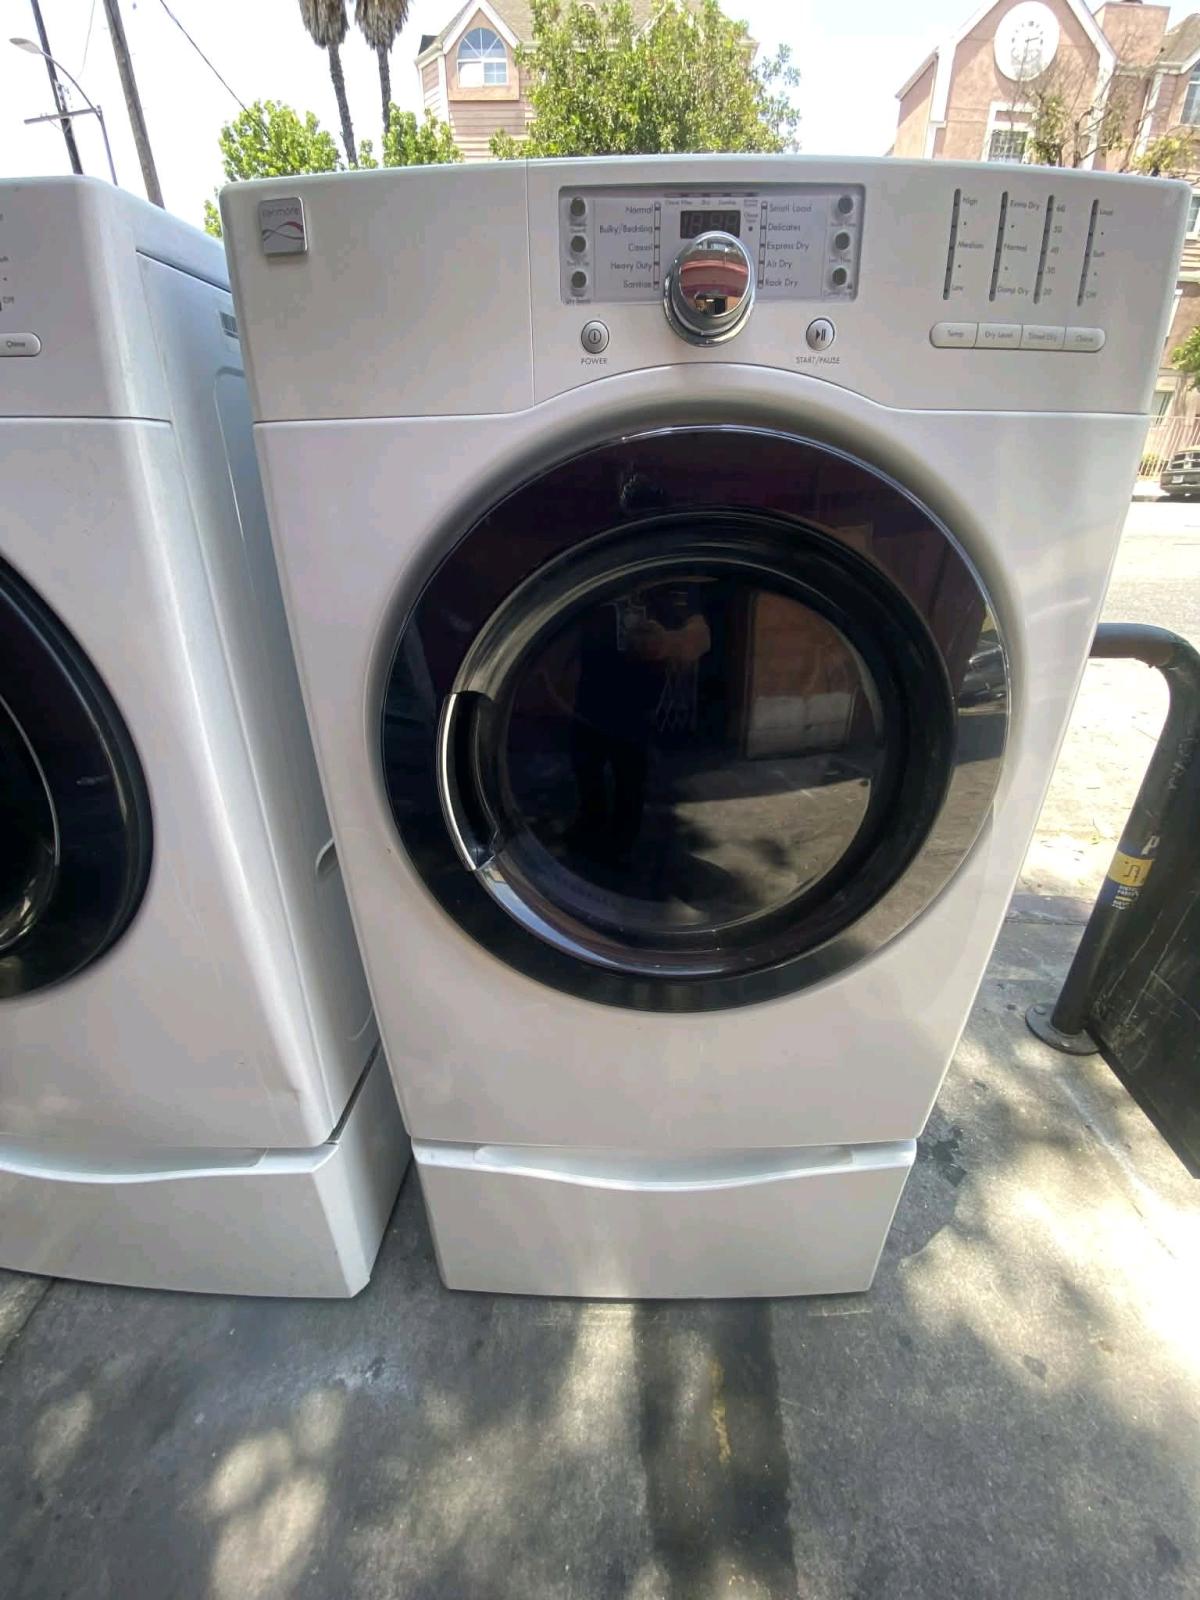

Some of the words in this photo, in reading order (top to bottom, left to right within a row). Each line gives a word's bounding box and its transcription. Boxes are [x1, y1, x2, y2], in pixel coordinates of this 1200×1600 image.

[625, 204, 653, 215] Normal
[769, 203, 789, 213] Small
[793, 203, 812, 213] Load
[796, 242, 810, 252] Dry
[610, 261, 634, 272] Heavy
[636, 261, 653, 272] Duty
[766, 259, 777, 268] Air
[779, 259, 793, 270] Dry
[784, 279, 799, 289] Dry
[580, 357, 608, 365] POWER
[795, 356, 841, 366] START/PAUSE
